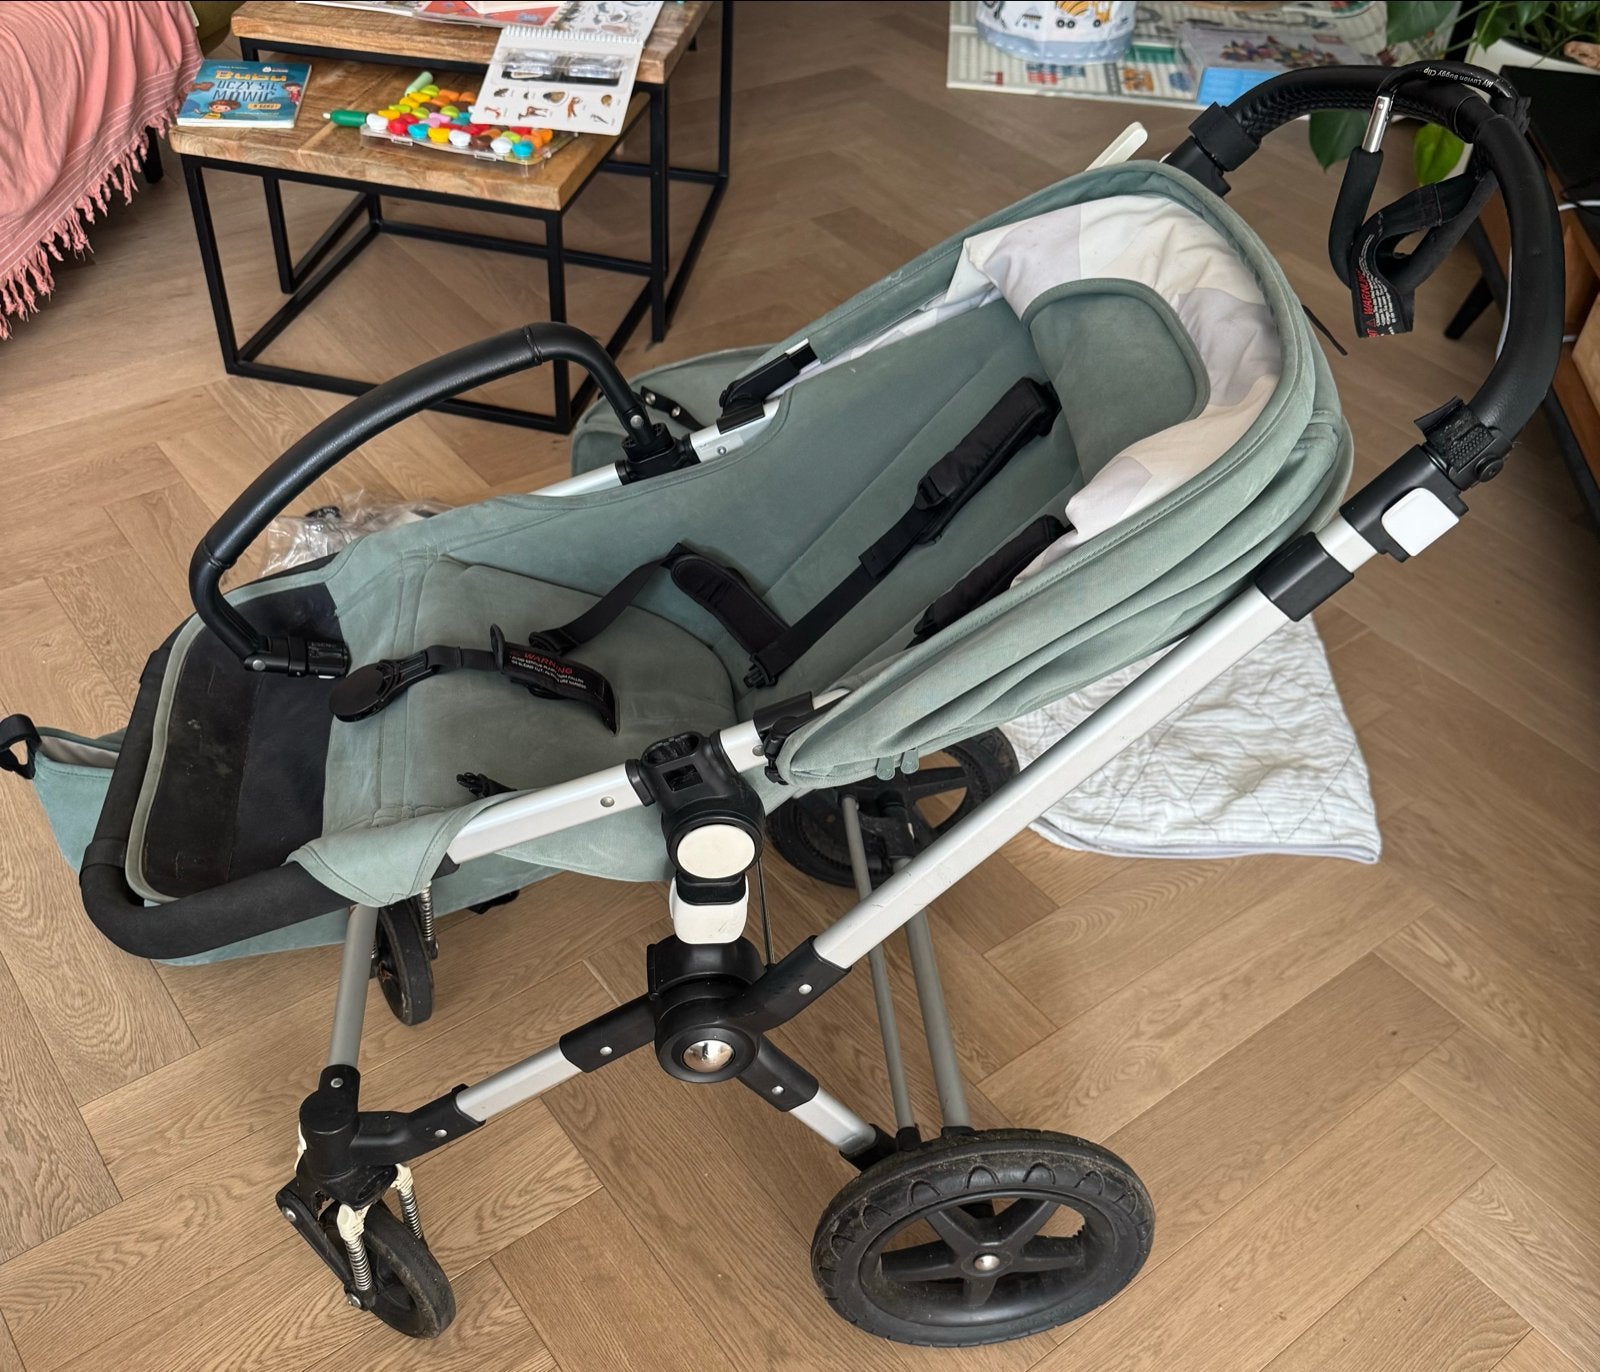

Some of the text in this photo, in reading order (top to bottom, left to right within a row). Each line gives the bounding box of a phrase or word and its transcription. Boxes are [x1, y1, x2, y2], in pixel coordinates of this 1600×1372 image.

[217, 80, 254, 90] UCZY
[1423, 67, 1494, 88] My Luvion Buggy Clip
[524, 652, 573, 675] WARNING
